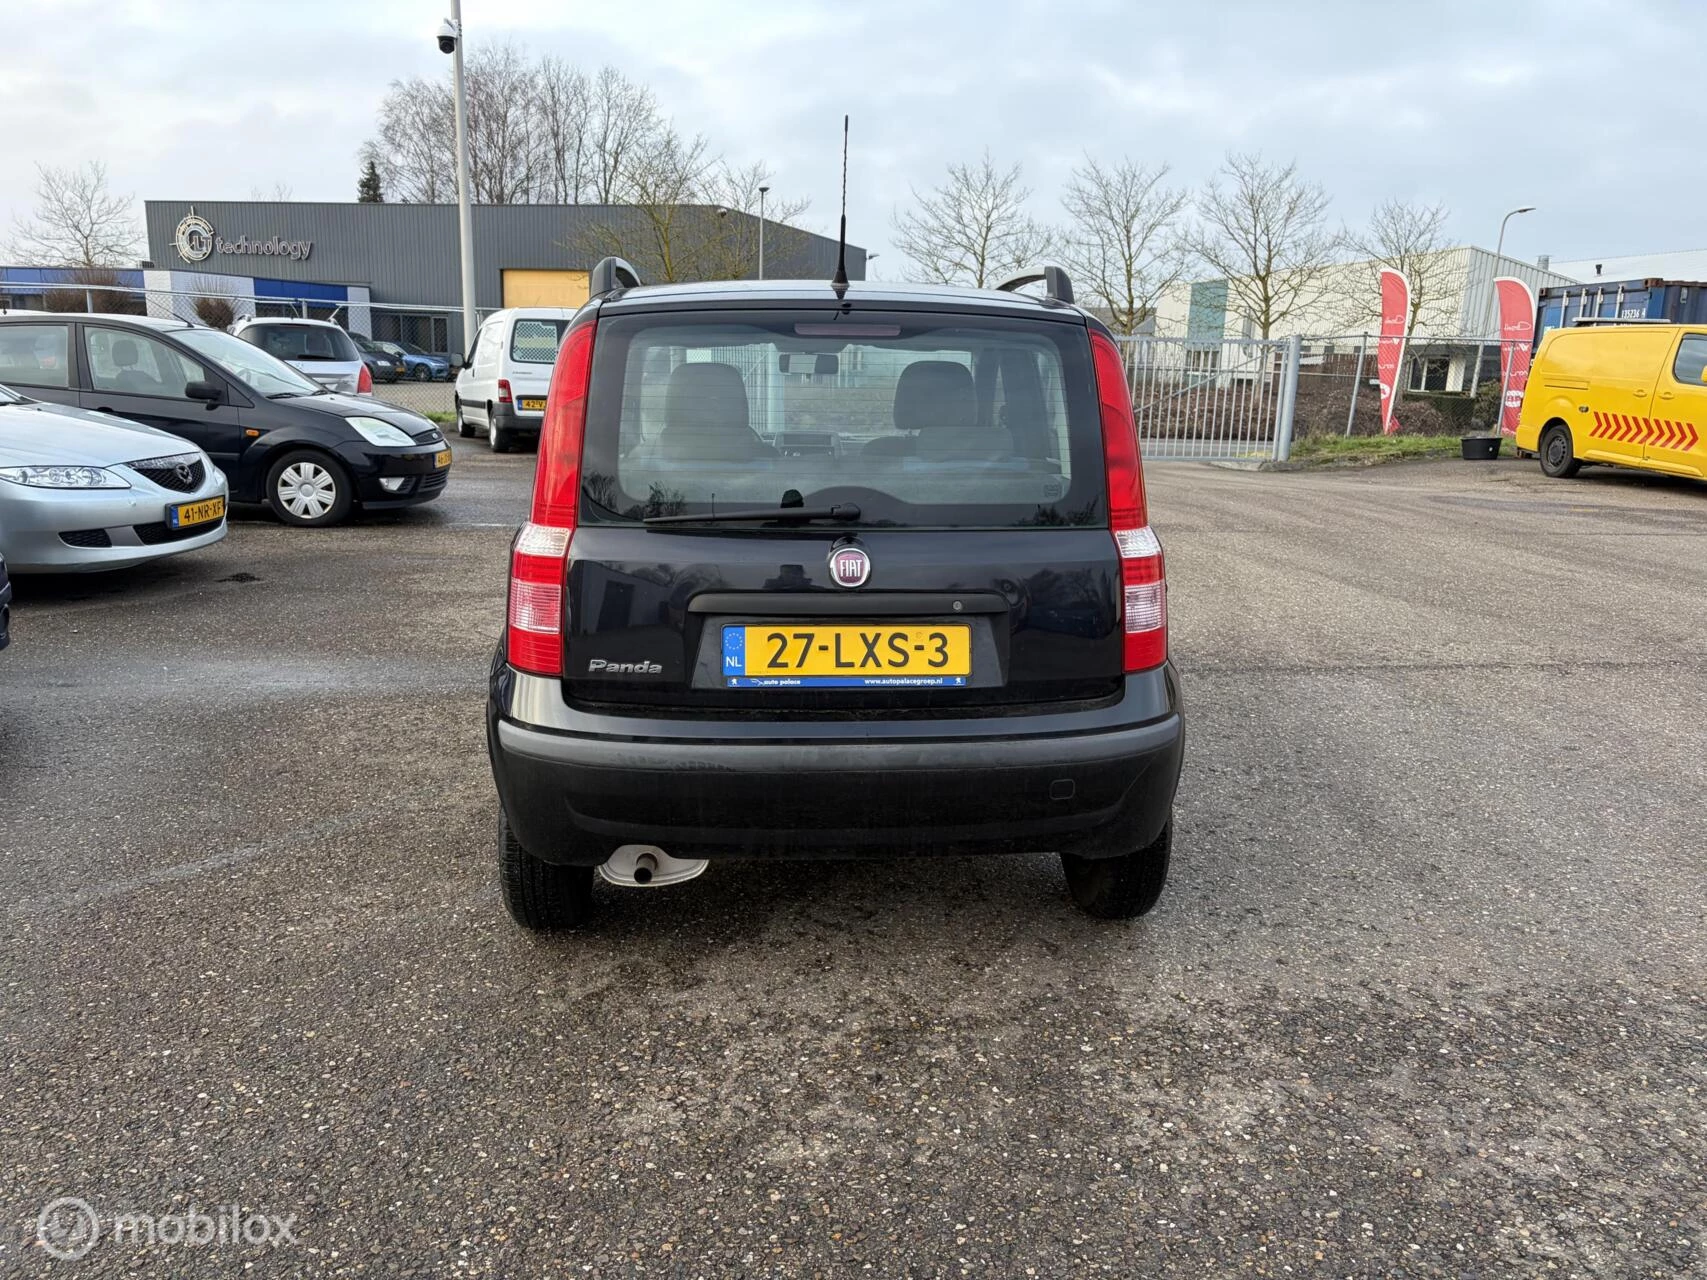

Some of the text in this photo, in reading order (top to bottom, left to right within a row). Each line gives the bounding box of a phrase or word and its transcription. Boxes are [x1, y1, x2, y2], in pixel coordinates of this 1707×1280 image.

[215, 234, 312, 261] technology
[184, 501, 222, 523] 41-NR-XF
[840, 559, 862, 577] FIAT
[767, 632, 949, 668] 27-LXS-3
[588, 659, 663, 674] Panda
[725, 656, 742, 668] NL
[864, 677, 943, 686] www.autopalacegroep.nl
